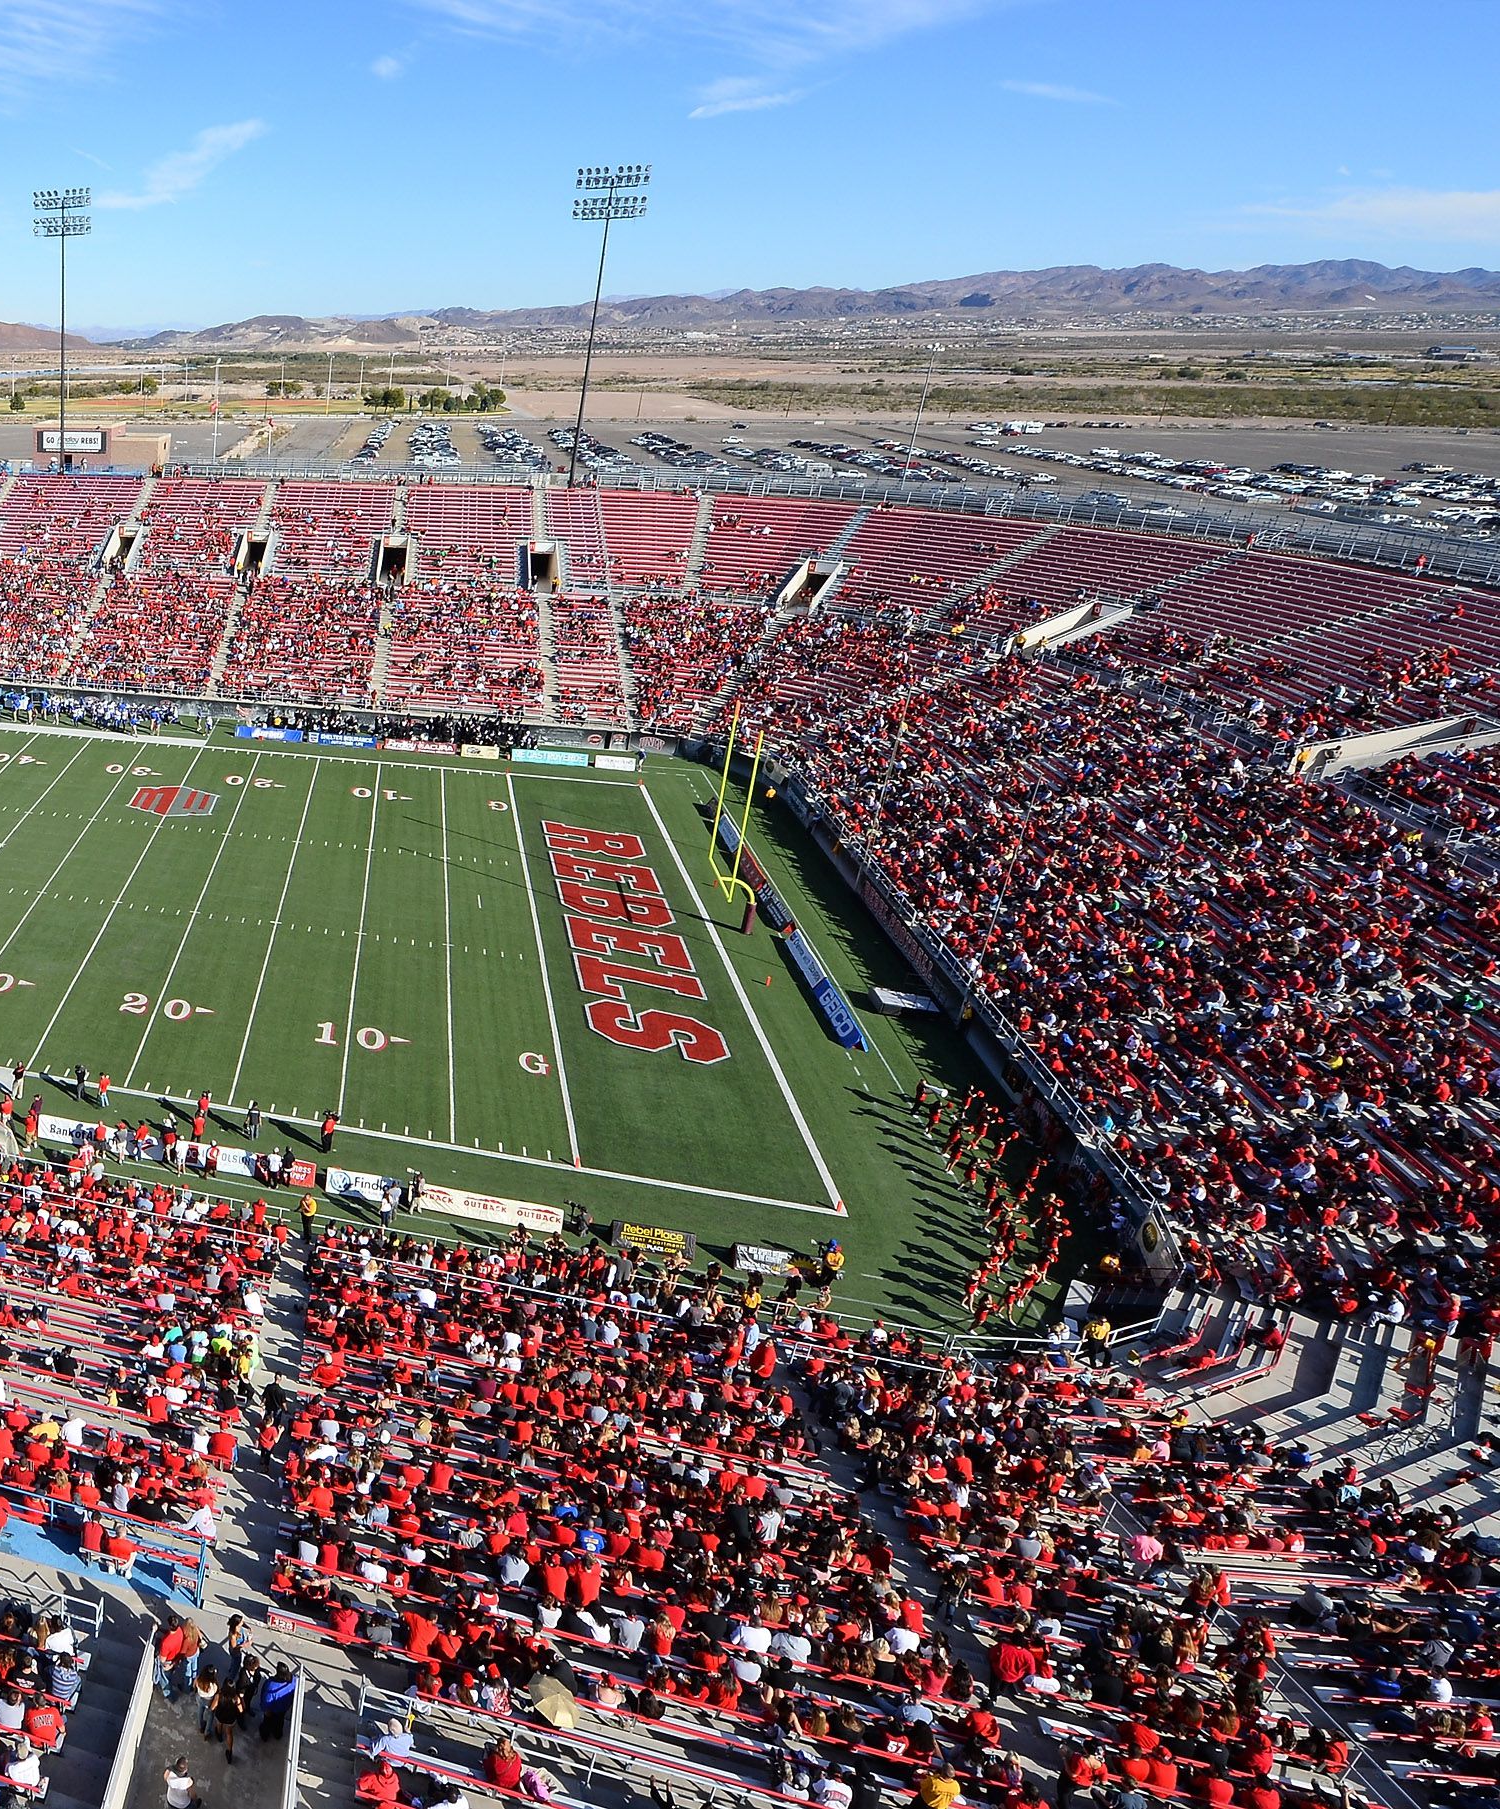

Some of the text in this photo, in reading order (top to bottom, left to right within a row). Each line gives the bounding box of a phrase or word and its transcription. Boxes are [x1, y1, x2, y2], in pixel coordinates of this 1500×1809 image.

[639, 736, 666, 751] UNLV
[105, 763, 152, 777] 30
[225, 775, 274, 787] 20
[352, 787, 398, 801] 10
[541, 820, 732, 1064] REBELS
[119, 993, 192, 1021] 20
[819, 988, 854, 1038] GEICO
[315, 1022, 387, 1052] 10
[518, 1052, 550, 1076] G
[50, 1124, 73, 1138] Bank
[74, 1130, 86, 1139] of
[354, 1176, 386, 1192] Findl
[425, 1193, 454, 1205] TBACK
[463, 1200, 507, 1213] OUTBACK
[517, 1209, 562, 1224] OUTBACK
[623, 1223, 684, 1242] Rebel Place
[621, 1234, 686, 1250] Student Apartments
[887, 1740, 906, 1756] 57
